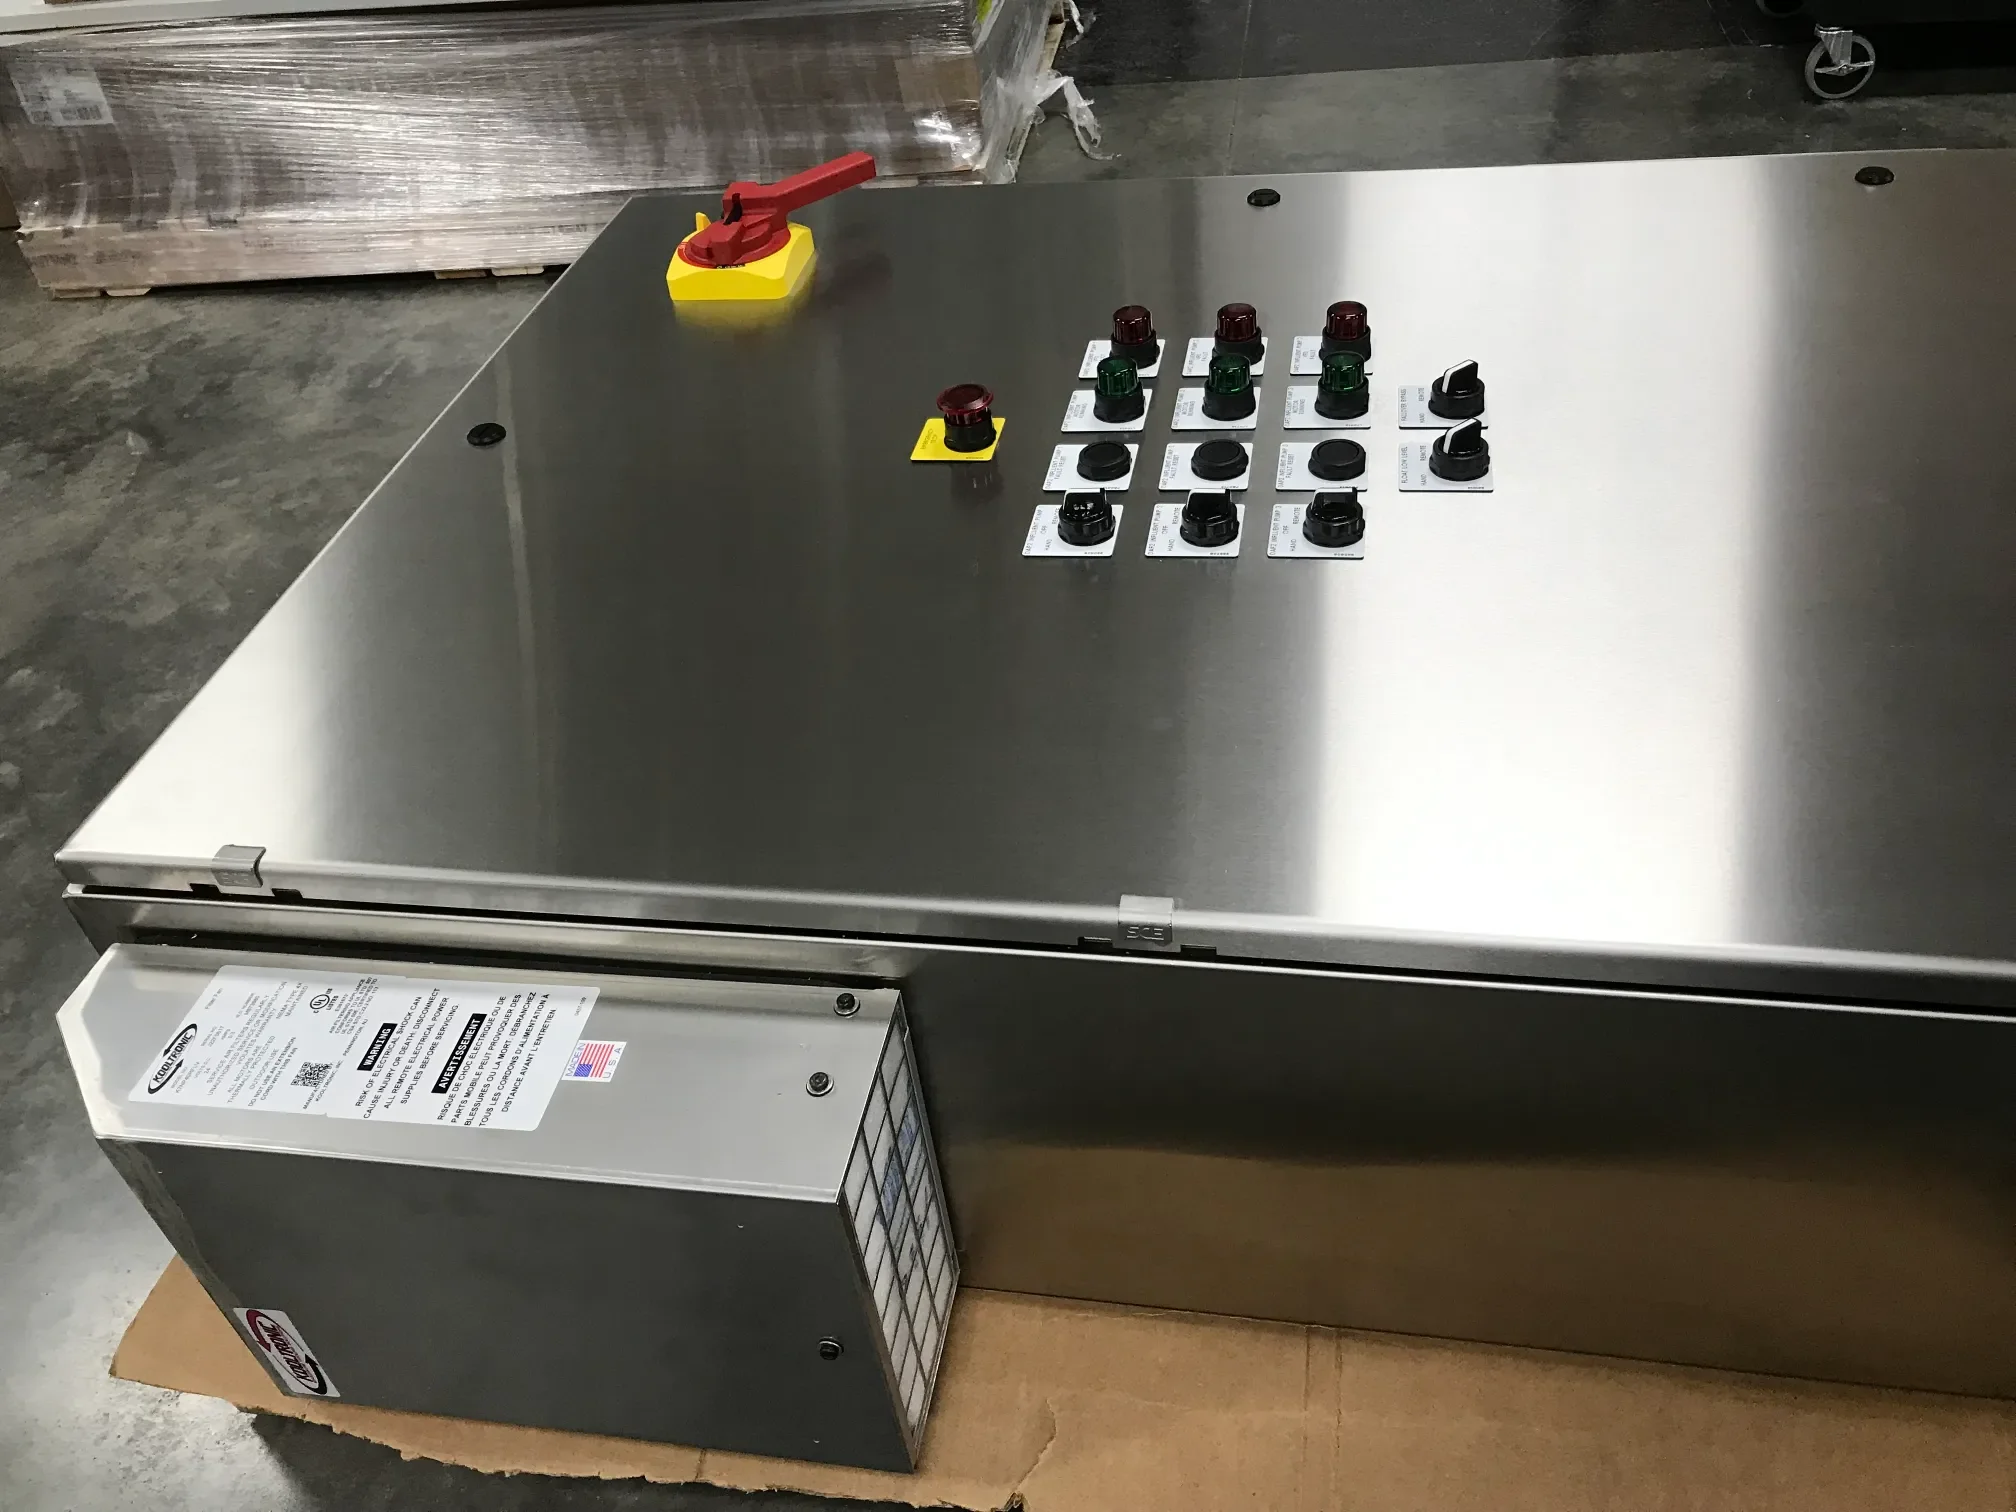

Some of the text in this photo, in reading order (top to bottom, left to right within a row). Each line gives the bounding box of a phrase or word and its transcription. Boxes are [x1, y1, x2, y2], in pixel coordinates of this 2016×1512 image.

[1171, 506, 1181, 524] REMOTE
[1291, 506, 1300, 524] REMOTE
[283, 984, 310, 1017] MAINTAINED
[284, 988, 299, 1003] TYPE
[324, 994, 340, 1011] LISTED
[490, 1005, 503, 1016] OU
[495, 995, 508, 1005] DE
[235, 1026, 257, 1051] SERVICE
[512, 999, 548, 1055] D'ALIMENTATION
[152, 1032, 195, 1083] KOOLTRONIC
[205, 1059, 227, 1083] SERVICE
[228, 1025, 249, 1049] FILTERS
[234, 1038, 258, 1066] VIOLATES
[353, 995, 423, 1107] RISK OF ELECTRICAL SHOCK CAN
[361, 1027, 392, 1066] WARNING
[361, 1093, 383, 1119] CAUSE
[375, 1066, 398, 1093] INJURY
[390, 1055, 404, 1067] OR
[410, 987, 442, 1029] DISCONNECT
[381, 996, 450, 1109] ALL REMOTE ELECTRICAL POWER
[398, 1002, 461, 1104] SUPPLIES BEFORE SERVICING.
[435, 1017, 482, 1089] AVERTISSEMENT
[448, 993, 523, 1123] PARTS MOBILE PEUT PROVOQUER DES
[490, 1059, 503, 1070] LA
[565, 1051, 582, 1077] MADE
[225, 1044, 263, 1093] ALL MOTORS ARE
[225, 1069, 254, 1104] THERMALLY
[247, 1034, 276, 1069] PROTECTED
[247, 1047, 280, 1090] OUTDOOR USE
[252, 1085, 266, 1098] NOT
[259, 1073, 274, 1086] USE
[272, 1035, 298, 1066] EXTENSION
[258, 1046, 298, 1101] CORD WITH THIS FAN
[456, 1059, 475, 1081] CHOC
[484, 1070, 498, 1082] OU
[494, 1054, 521, 1091] CORDONS
[498, 1076, 524, 1112] DISTANCE
[517, 1052, 536, 1076] AVANT
[450, 1081, 463, 1092] DE
[461, 1082, 492, 1126] BLESSURES
[487, 1091, 502, 1106] LES
[435, 1092, 458, 1120] RISQUE
[476, 1106, 495, 1127] TOUS
[257, 1320, 318, 1384] KOOLTRONIC
